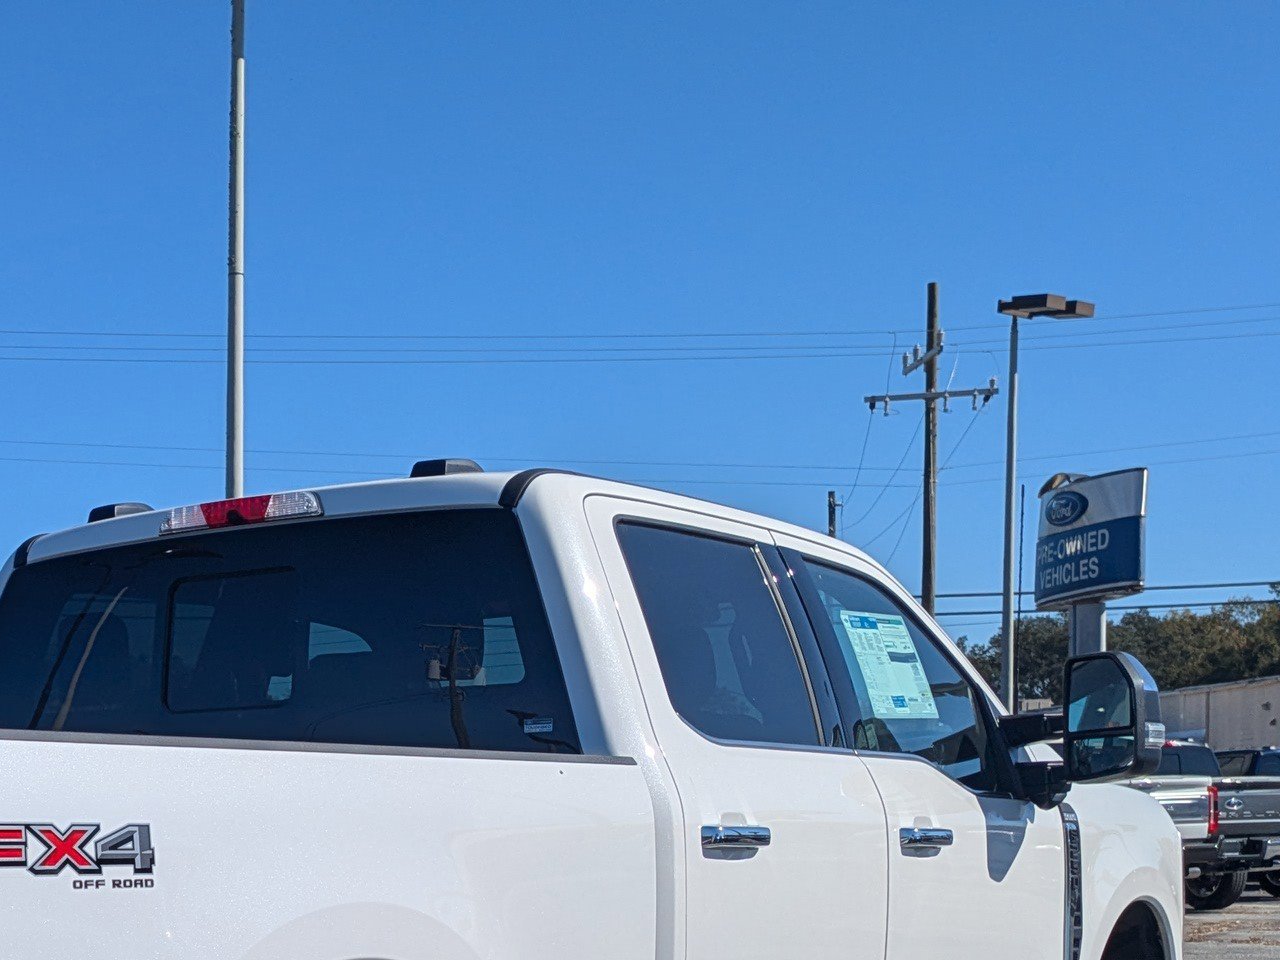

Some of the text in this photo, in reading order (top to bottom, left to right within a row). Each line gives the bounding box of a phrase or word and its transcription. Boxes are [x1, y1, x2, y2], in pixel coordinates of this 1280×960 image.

[1037, 528, 1110, 565] PRE-OWNED
[1039, 557, 1099, 590] VEHICLES
[72, 878, 154, 889] OFF ROAD
